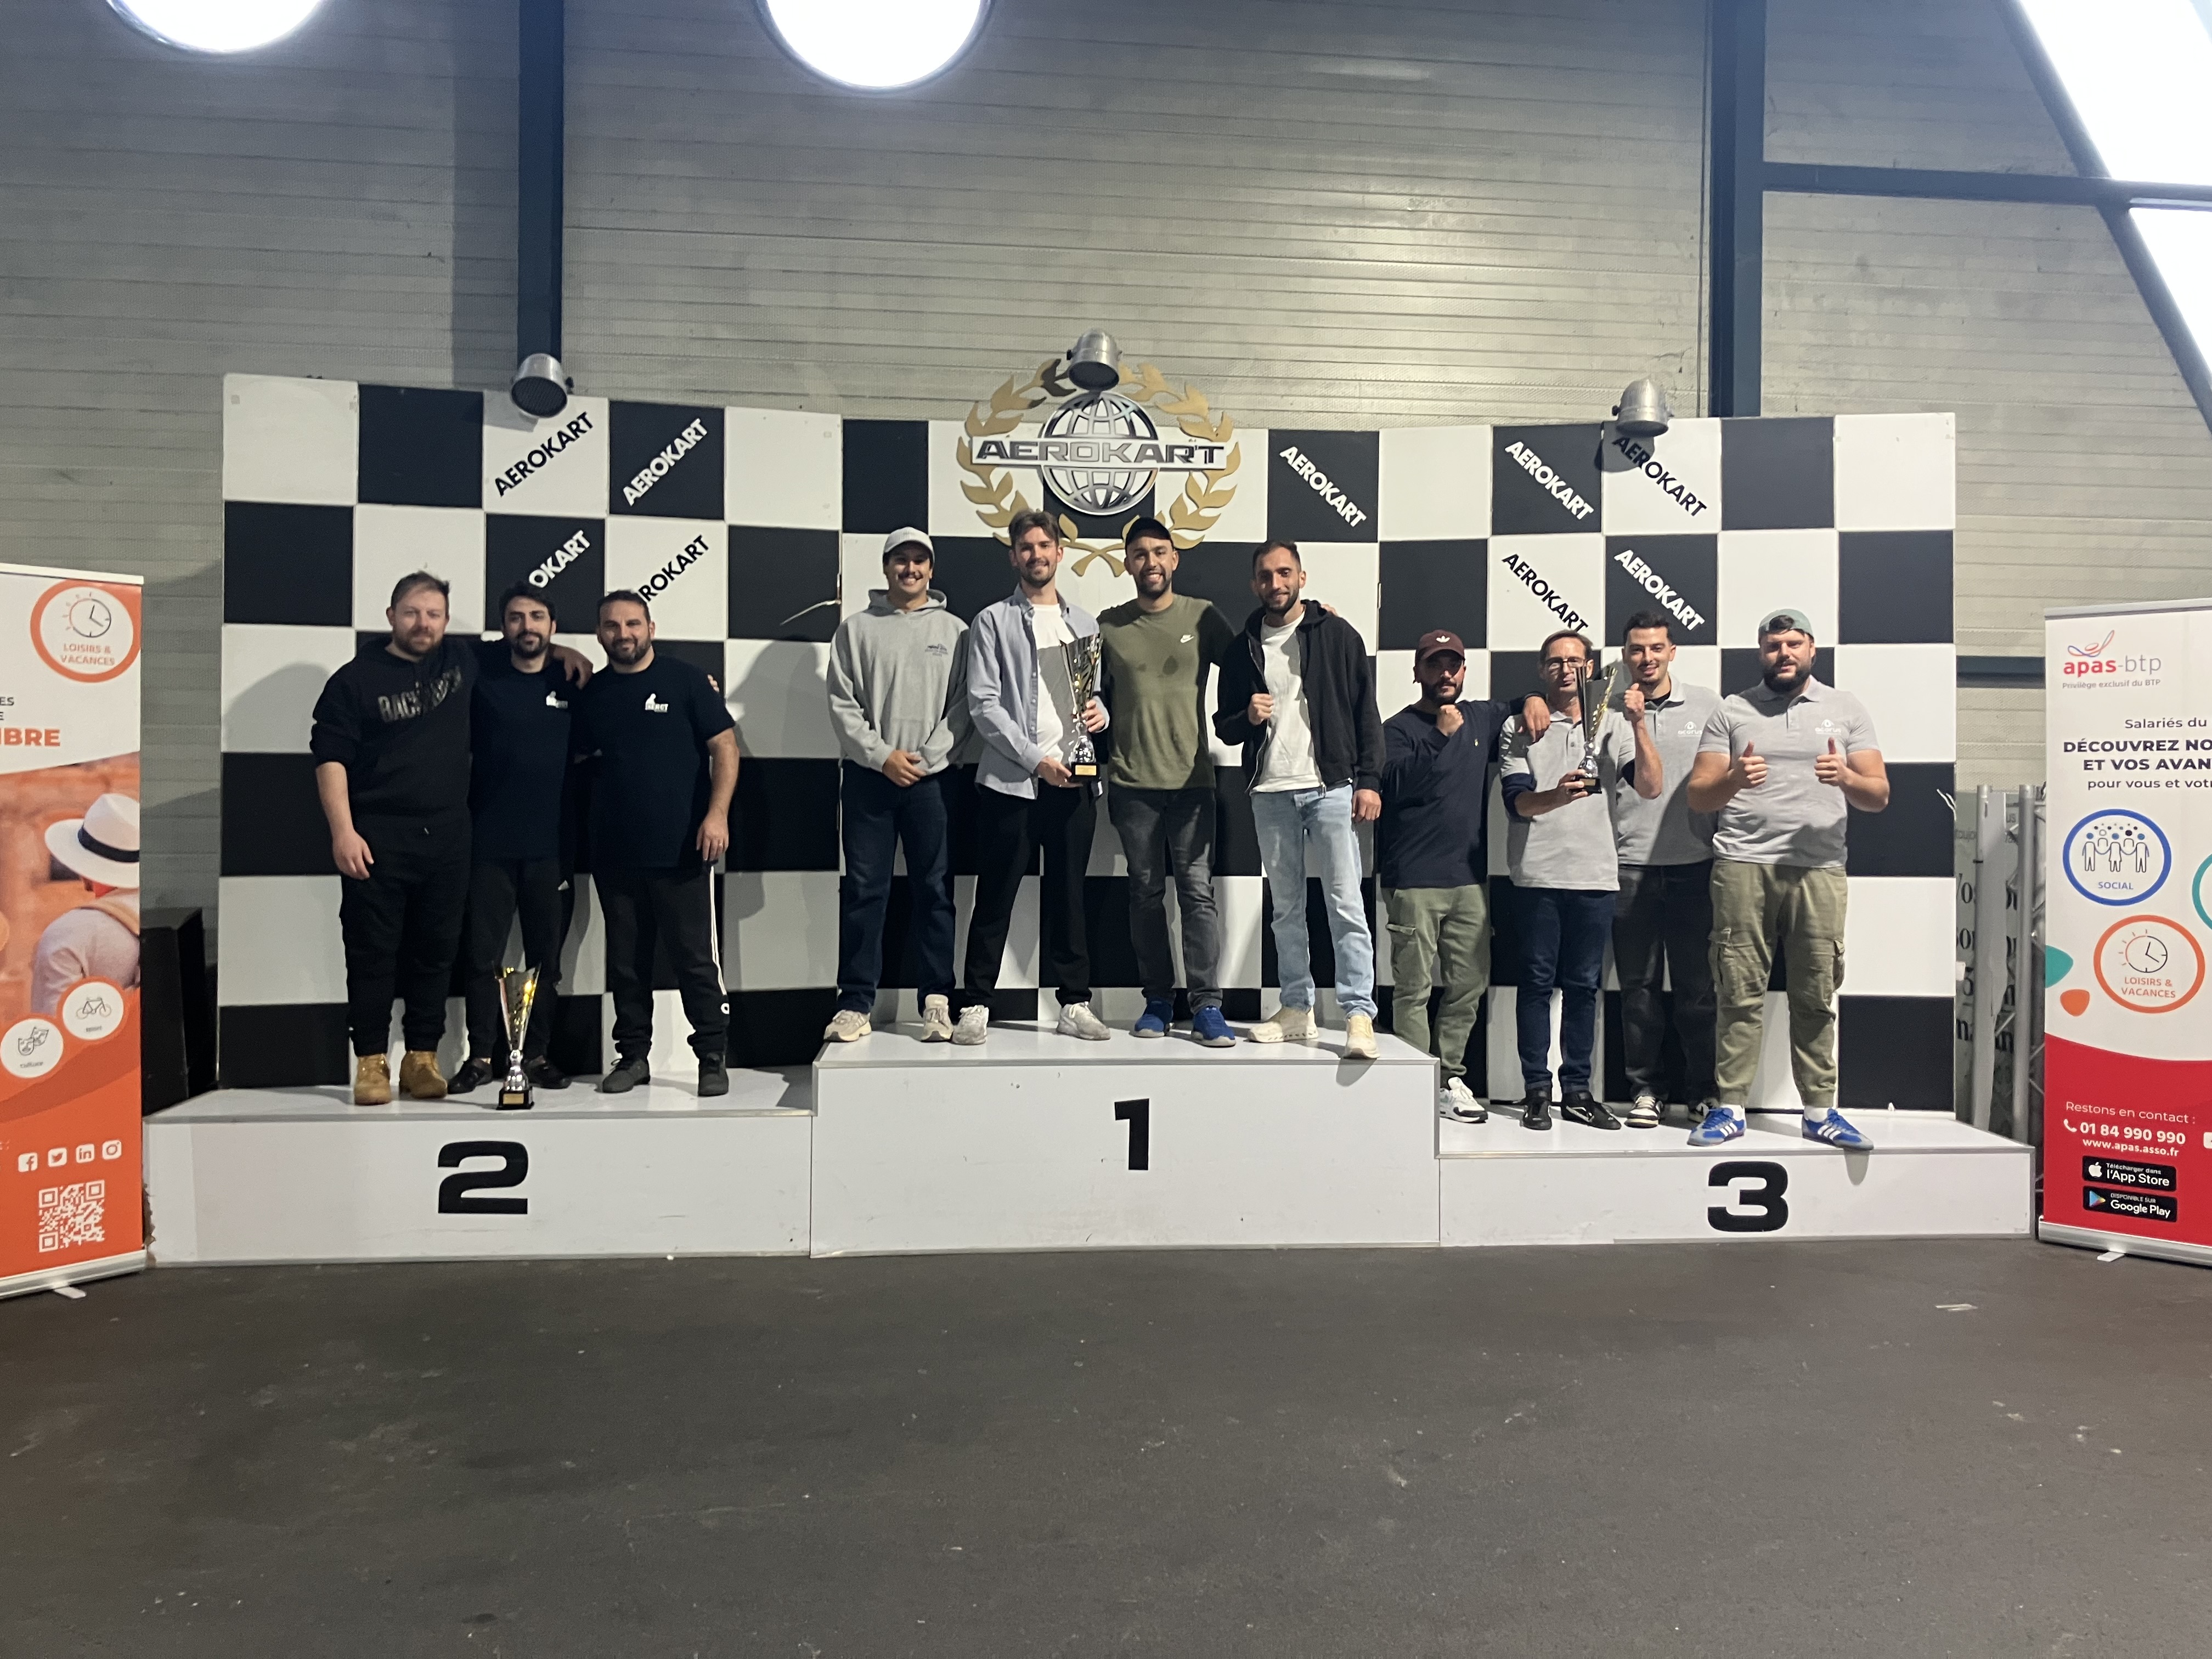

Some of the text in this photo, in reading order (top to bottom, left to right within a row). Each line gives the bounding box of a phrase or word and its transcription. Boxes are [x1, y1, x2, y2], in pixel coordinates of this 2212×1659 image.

[494, 411, 593, 496] AEROKART
[623, 417, 708, 506] AEROKART
[975, 440, 1224, 464] AEROKART
[1279, 445, 1367, 528] AEROKART
[1505, 441, 1594, 520] AEROKART
[1612, 437, 1707, 517] AEROKART
[529, 530, 590, 588] OKART
[639, 535, 709, 603] ROKART
[1502, 554, 1589, 633] AEROKART
[1614, 549, 1705, 630] AEROKART
[64, 644, 101, 653] LOISIRS
[61, 655, 115, 665] VACANCES
[2063, 654, 2162, 678] apas-btp
[2125, 718, 2207, 729] Salariés du
[0, 727, 60, 746] BRE
[2063, 738, 2179, 752] DÉCOUVREZ
[2084, 759, 2105, 770] ET
[2111, 759, 2150, 770] VOS
[2088, 780, 2121, 790] pour
[2165, 779, 2180, 788] et
[2098, 881, 2134, 890] SOCIAL
[2121, 988, 2176, 998] VACANCES
[2124, 977, 2172, 987] LOISIRS &
[2066, 1101, 2116, 1115] Restons
[2119, 1109, 2135, 1118] en
[2139, 1111, 2188, 1123] contact
[1114, 1098, 1150, 1171] 1
[2080, 1122, 2186, 1144] 01 84 990 990
[2083, 1138, 2179, 1156] www.apas.asso.fr
[438, 1140, 528, 1214] 2
[2106, 1163, 2144, 1173] Télécharger
[2107, 1169, 2170, 1186] l'App Store
[1707, 1161, 1788, 1232] 3
[2111, 1193, 2143, 1202] DISPONIBLE
[2111, 1199, 2170, 1218] Google Play
